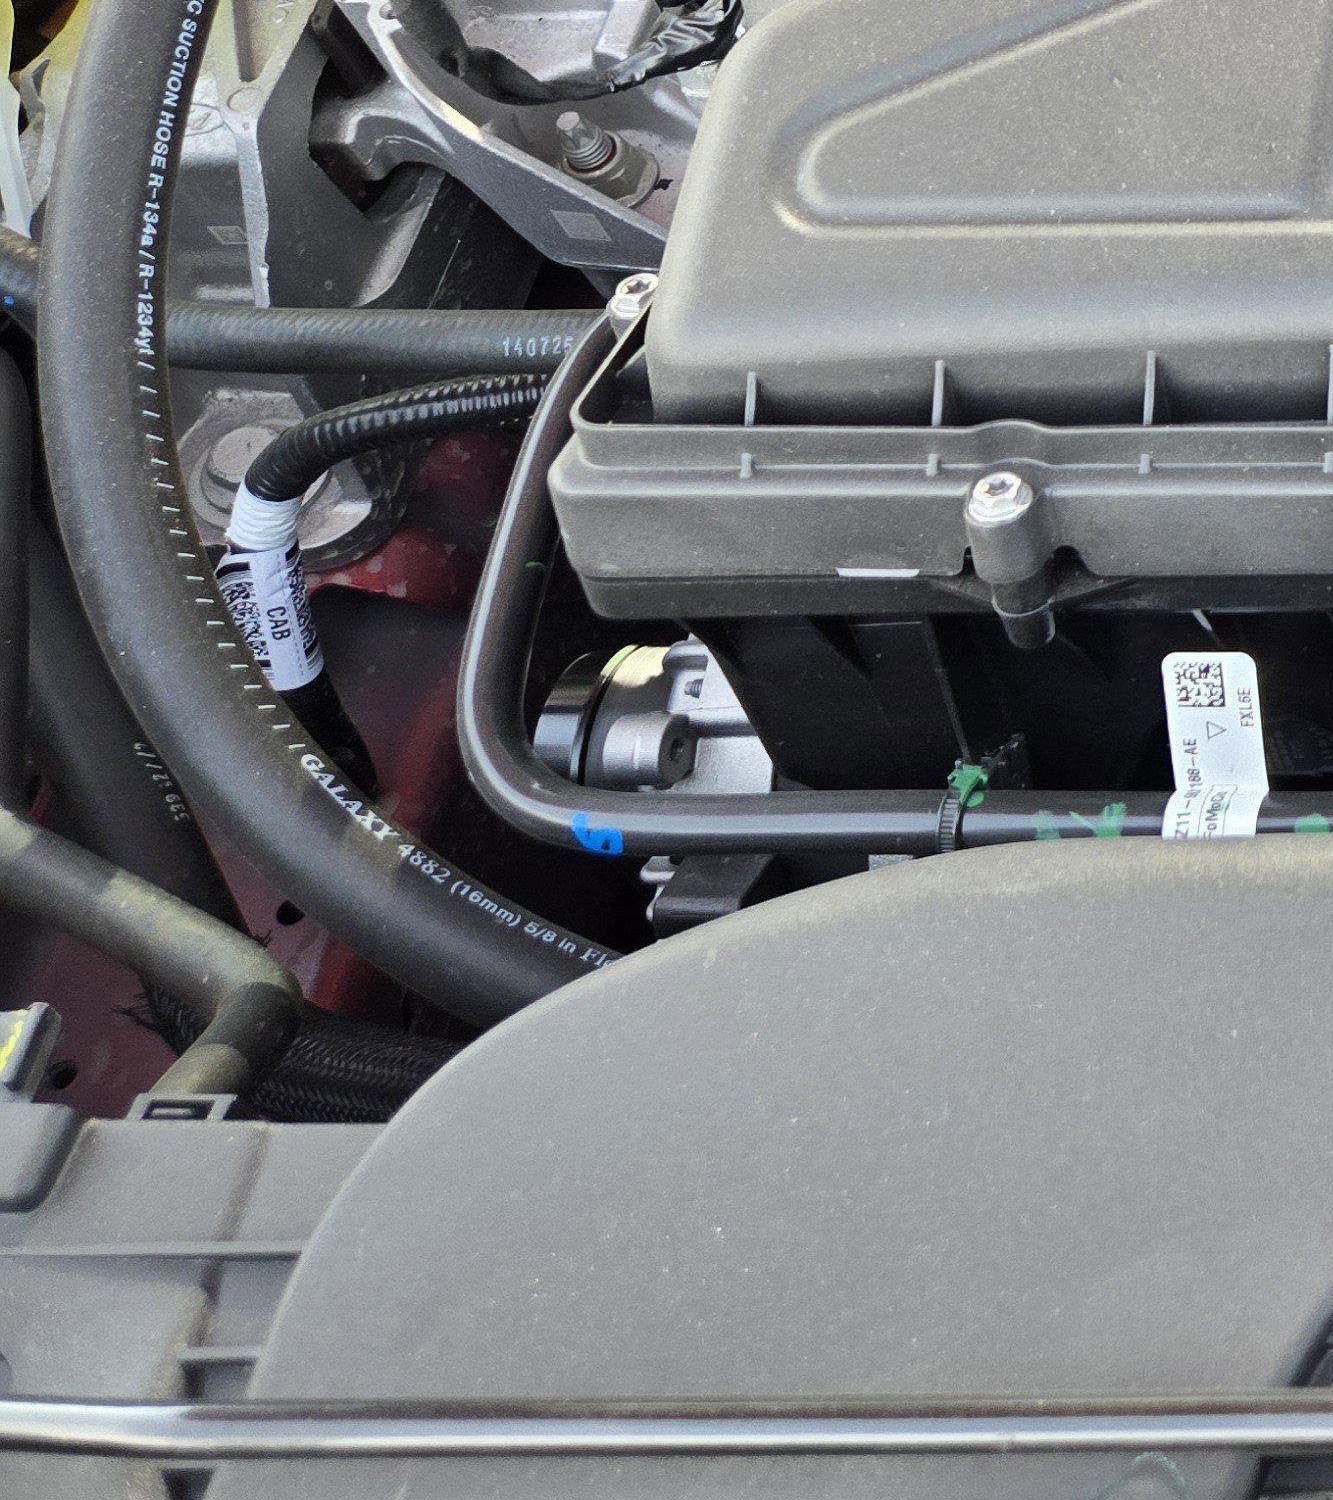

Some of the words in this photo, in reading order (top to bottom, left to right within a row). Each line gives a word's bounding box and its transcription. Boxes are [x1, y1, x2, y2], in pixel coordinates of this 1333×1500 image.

[162, 18, 197, 108] SUCTION
[150, 110, 176, 170] HOSE
[141, 173, 164, 246] R-134a
[134, 263, 156, 356] R-1234yf
[266, 606, 292, 640] CAB
[1237, 687, 1254, 727] FXL6E
[301, 753, 400, 842] GALAXY
[398, 842, 451, 884] 4882
[450, 879, 522, 927] (16mm)
[524, 921, 558, 944] 5/8
[557, 937, 576, 954] in
